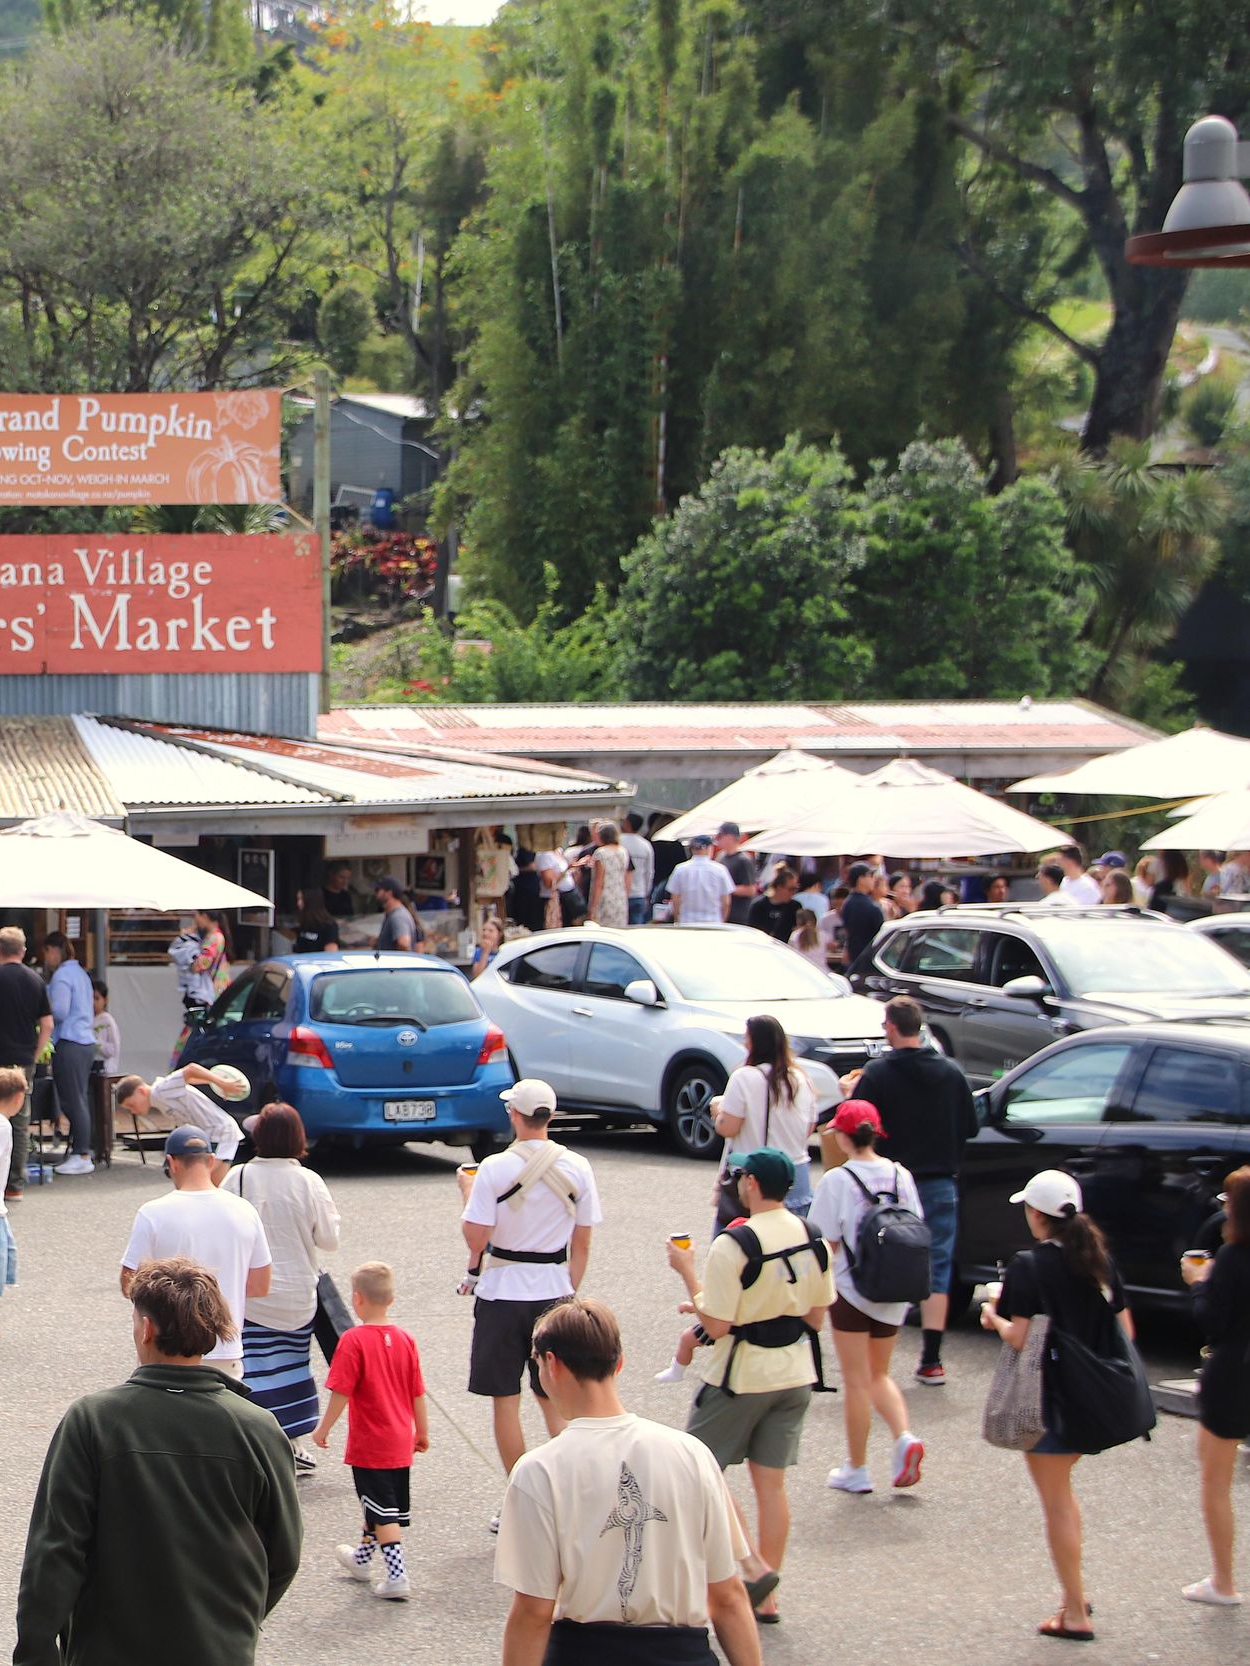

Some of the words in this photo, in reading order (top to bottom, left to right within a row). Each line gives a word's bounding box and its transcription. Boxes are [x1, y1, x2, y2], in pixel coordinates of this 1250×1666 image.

[77, 397, 213, 447] Pumpkin
[61, 434, 149, 462] Contest
[77, 473, 129, 486] WEIGH-IN
[130, 473, 170, 486] MARCH
[73, 549, 213, 597] Village
[69, 593, 277, 651] Market
